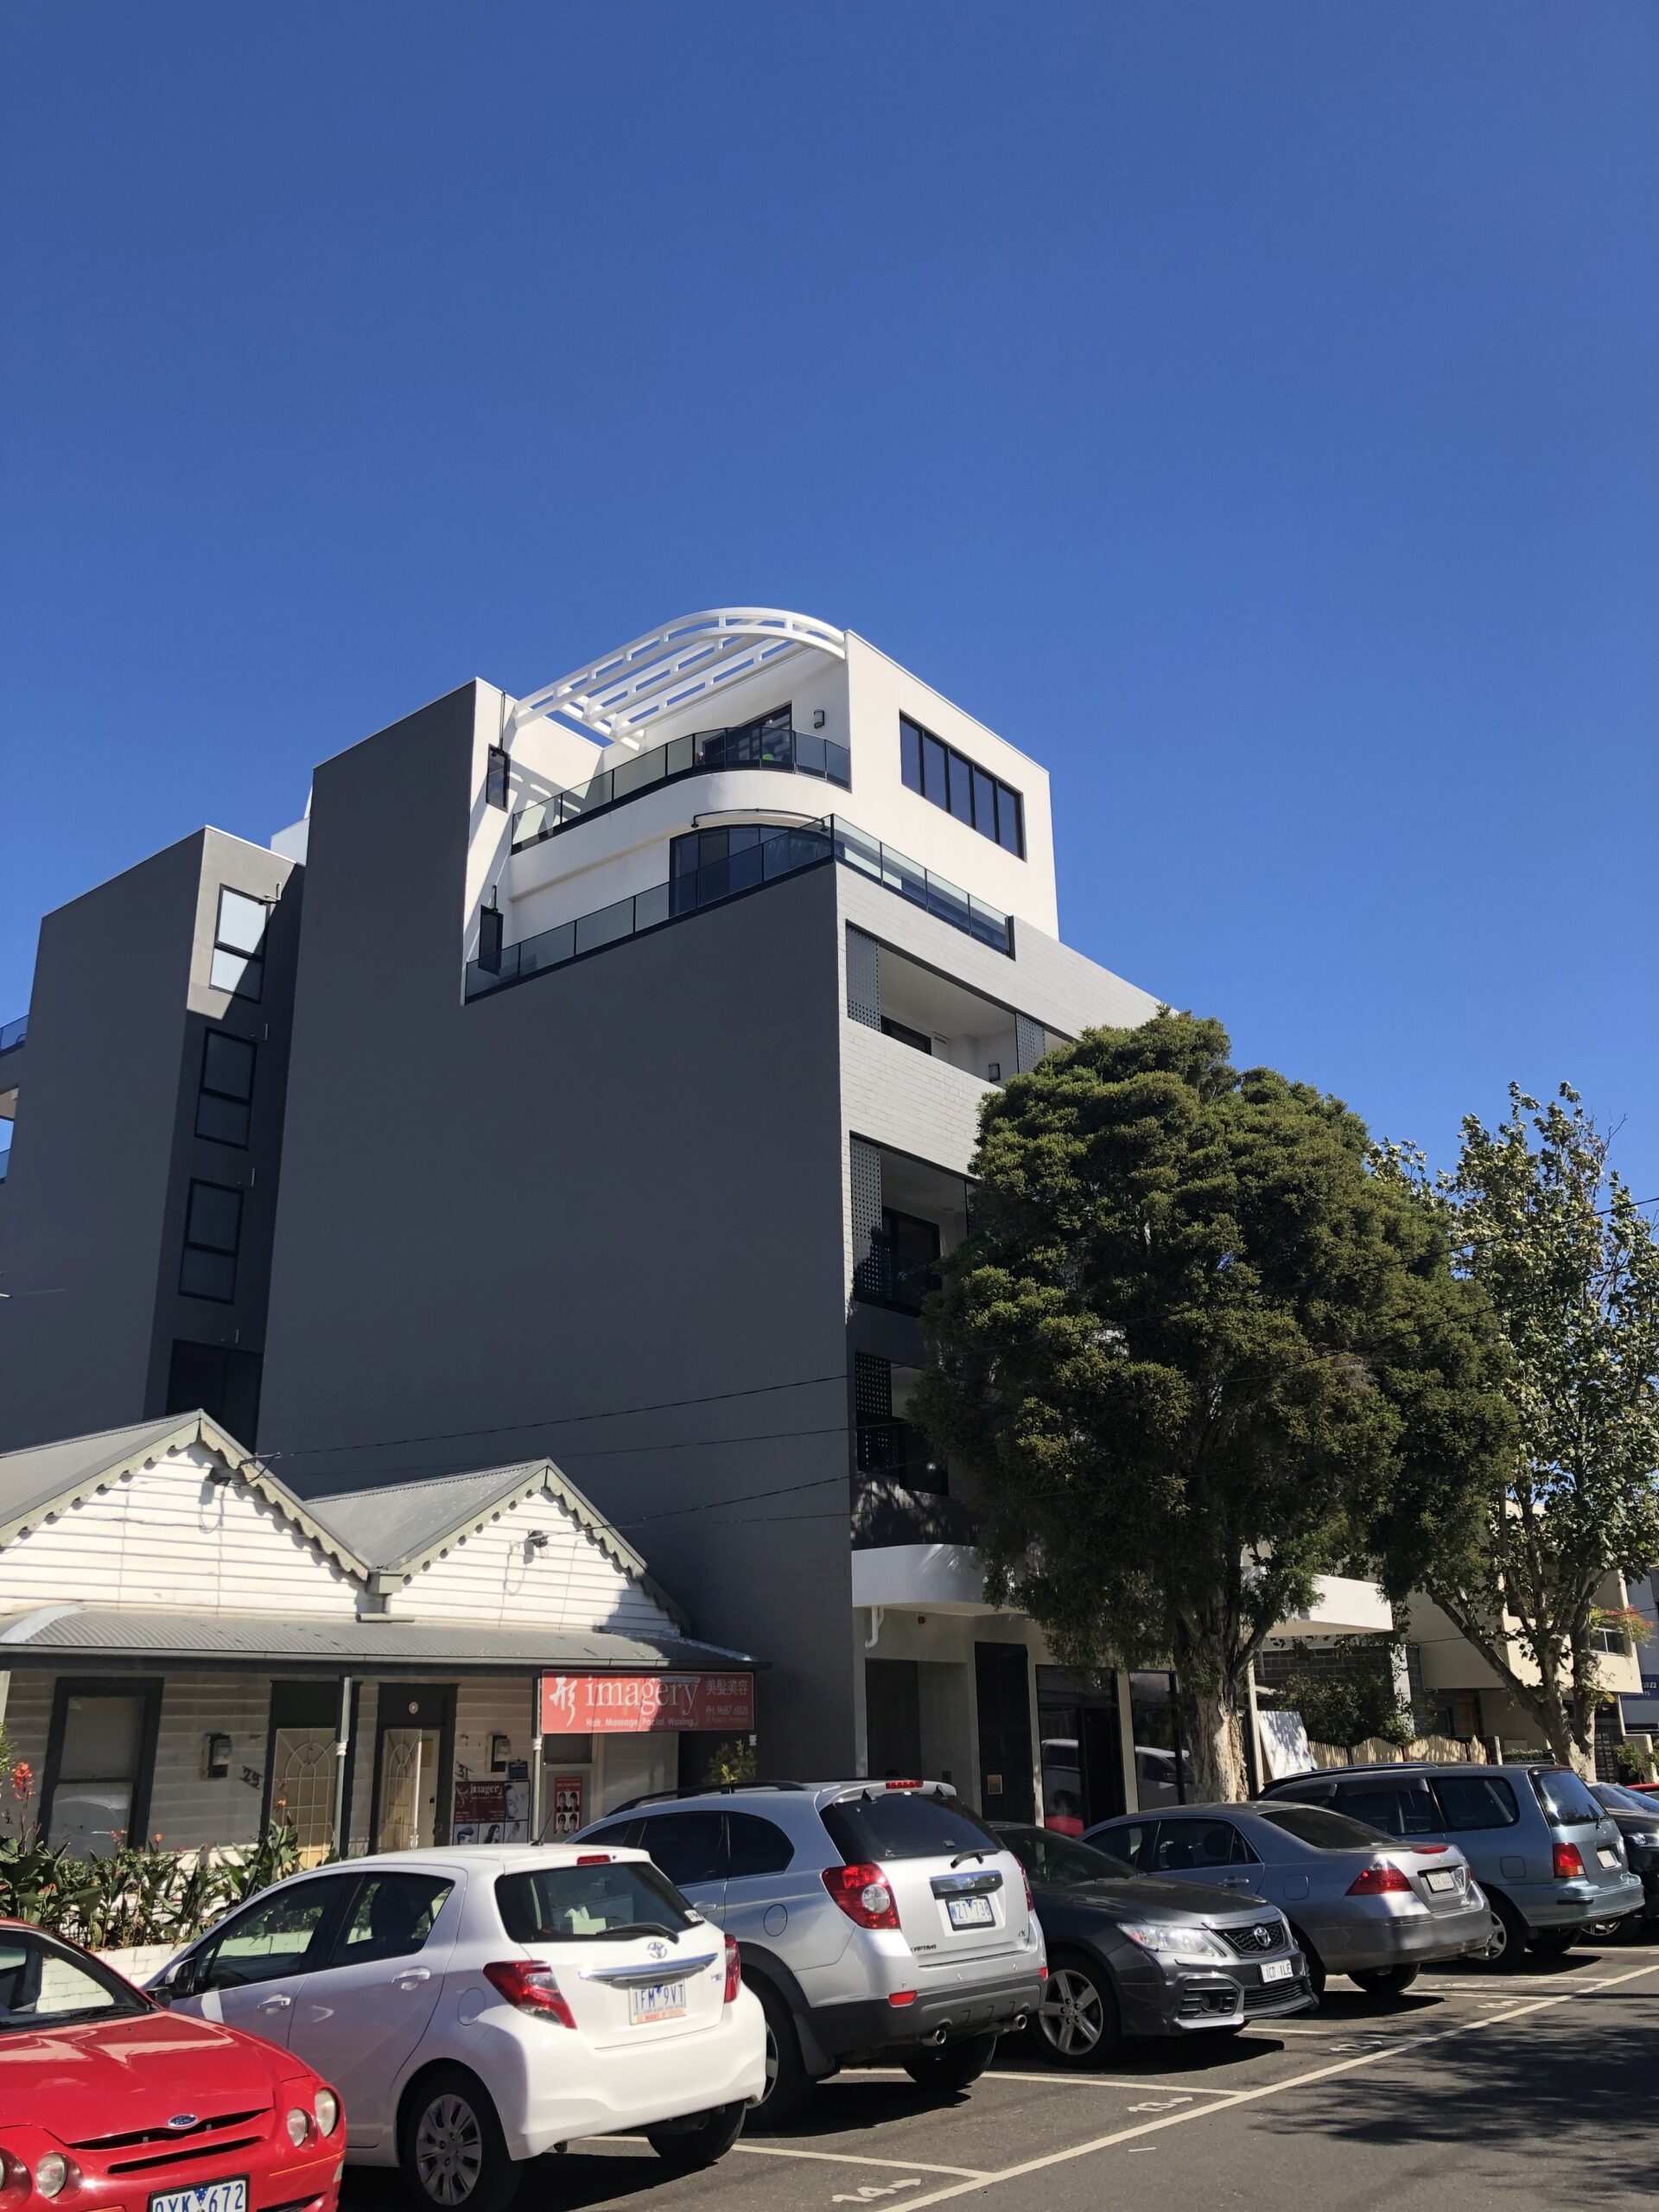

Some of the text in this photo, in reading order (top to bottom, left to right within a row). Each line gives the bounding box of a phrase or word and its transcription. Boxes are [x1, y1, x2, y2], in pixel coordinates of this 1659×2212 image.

[586, 1675, 700, 1715] imagery
[1127, 2101, 1173, 2113] 13
[208, 2183, 245, 2212] 672
[832, 2186, 895, 2202] 14
